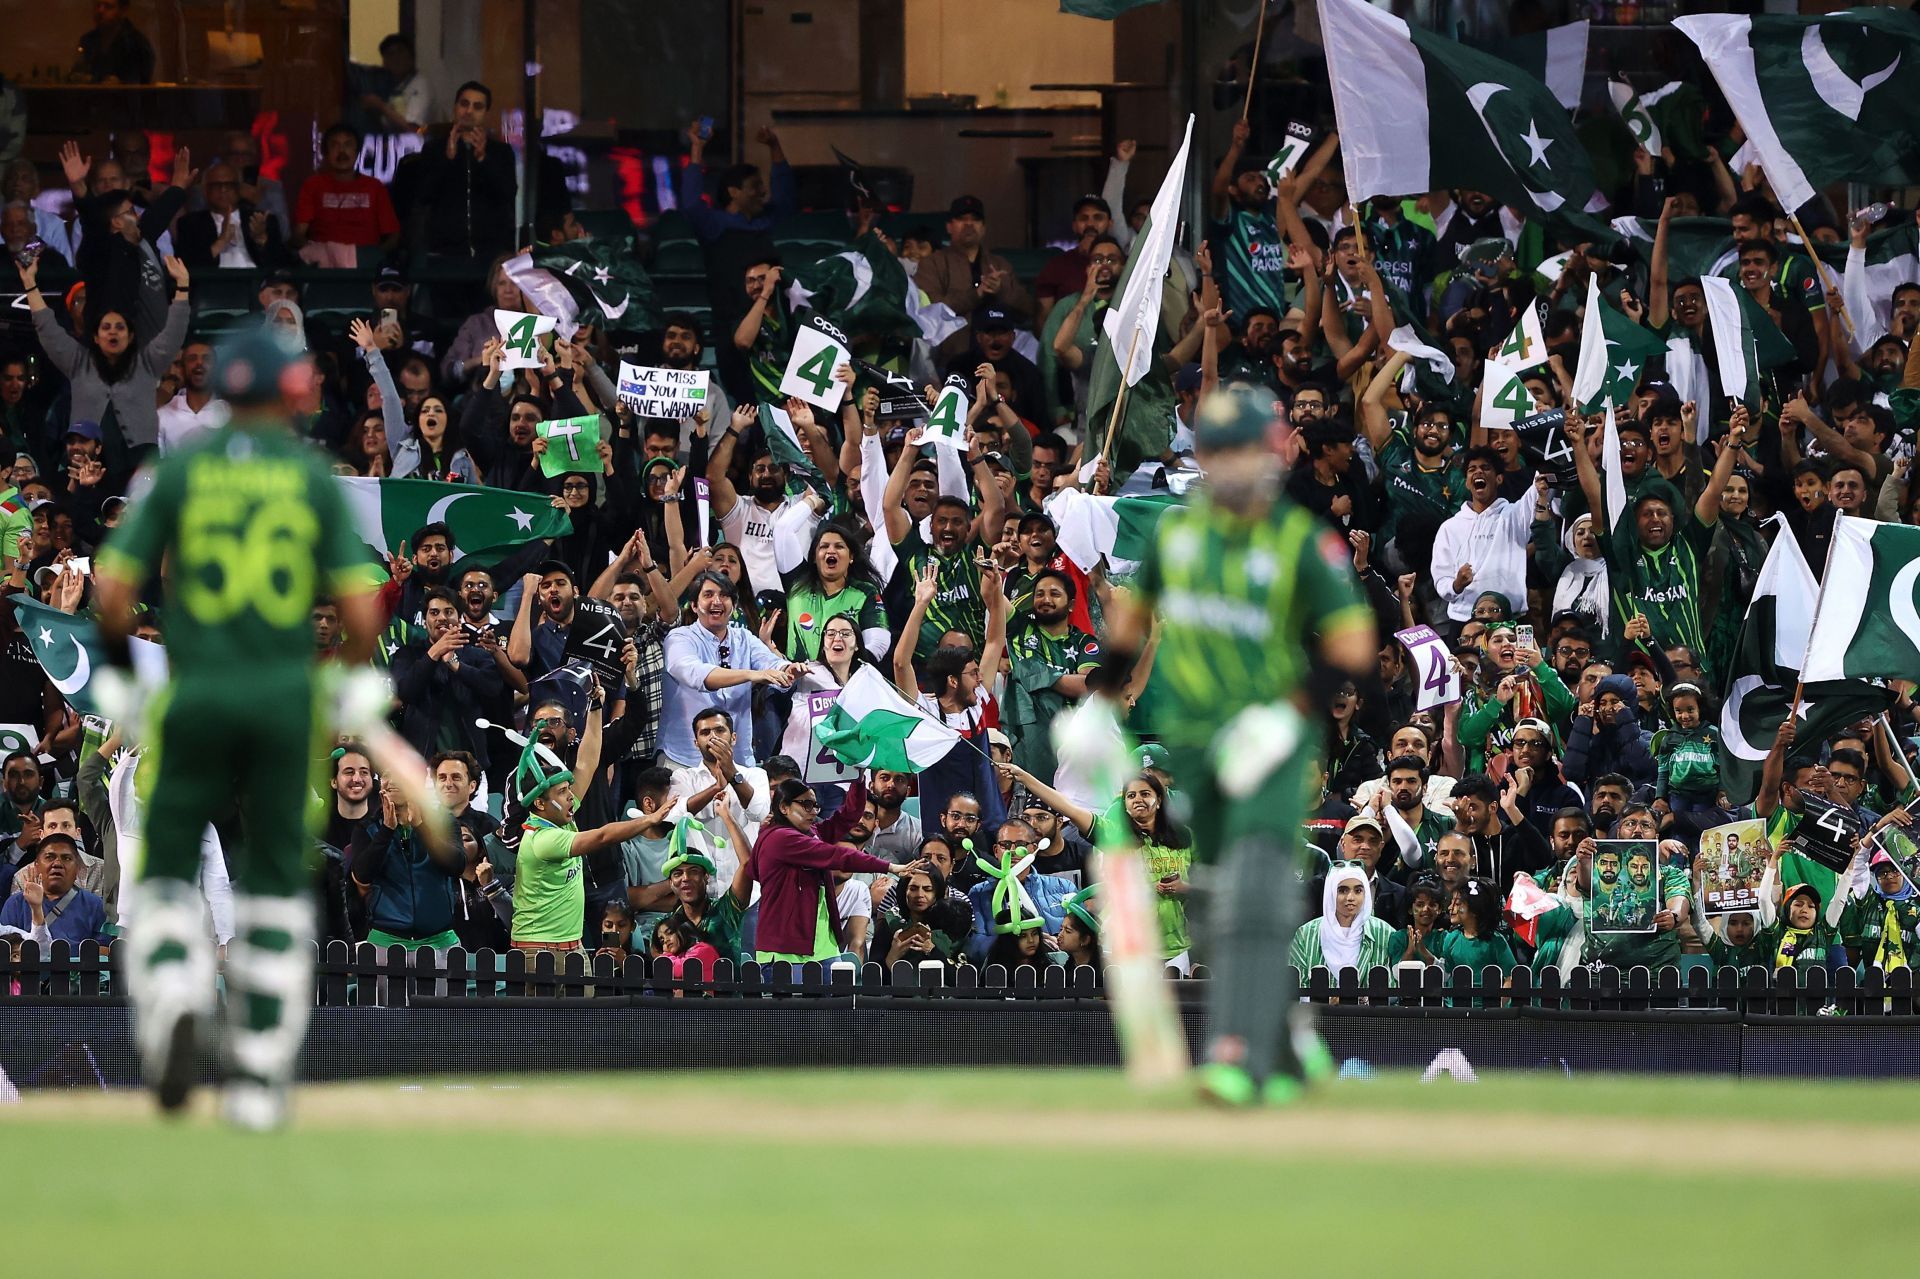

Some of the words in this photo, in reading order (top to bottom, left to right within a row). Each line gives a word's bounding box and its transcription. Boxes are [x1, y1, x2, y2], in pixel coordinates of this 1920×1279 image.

[507, 315, 538, 359] 4
[814, 316, 848, 344] oppo
[1501, 318, 1533, 361] 4
[633, 368, 659, 382] WE
[666, 373, 697, 385] MISS
[797, 345, 838, 397] 4
[945, 374, 968, 389] ppo
[618, 394, 657, 416] SHANE
[649, 384, 677, 397] YOU
[1493, 376, 1534, 422] 4
[928, 391, 960, 437] 4
[1517, 412, 1564, 431] NISSAN
[547, 419, 583, 461] 4
[1544, 427, 1574, 462] 4
[580, 602, 623, 622] NISSAN
[582, 623, 617, 659] 4
[1424, 645, 1451, 697] 4
[1816, 807, 1847, 843] 4
[1709, 887, 1760, 902] BEST
[1715, 897, 1758, 909] WISHES
